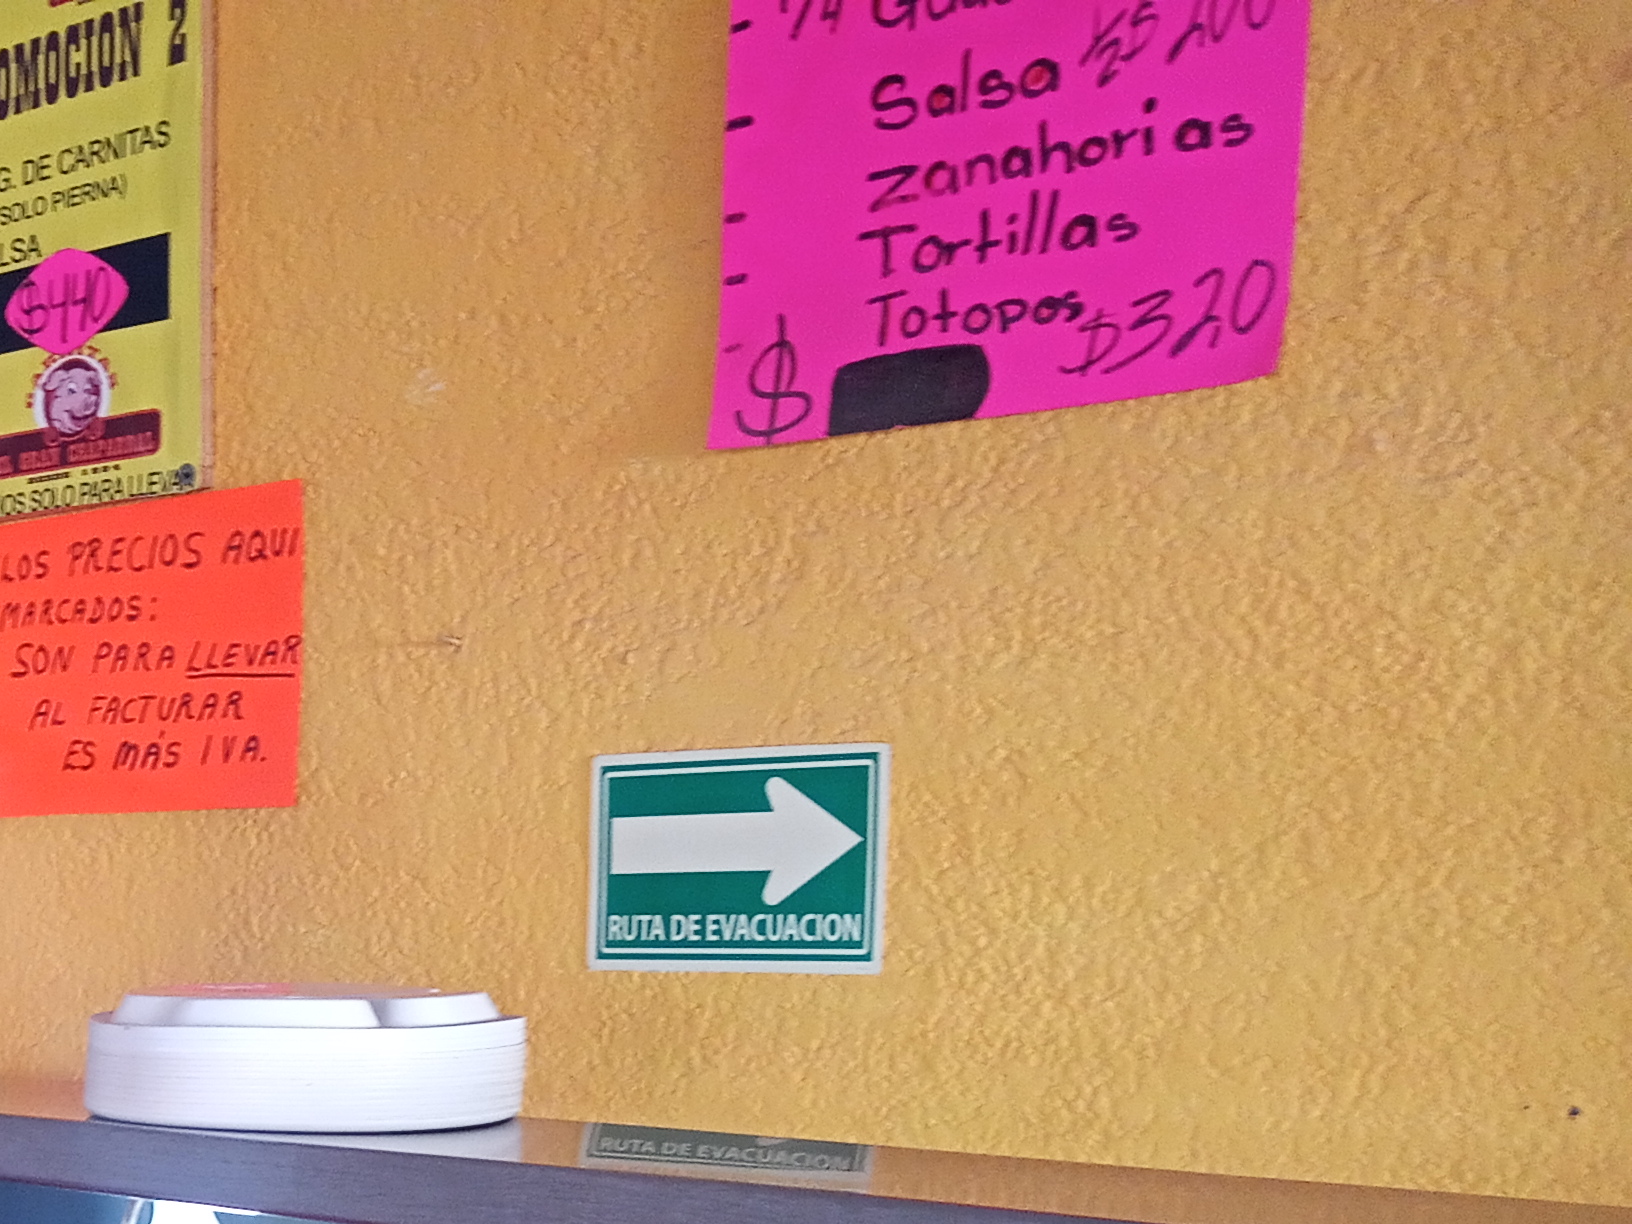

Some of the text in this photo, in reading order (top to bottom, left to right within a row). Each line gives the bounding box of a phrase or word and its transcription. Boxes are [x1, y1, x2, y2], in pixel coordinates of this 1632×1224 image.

[166, 0, 188, 67] 2
[871, 49, 1061, 130] Salsa
[22, 153, 52, 186] DE
[56, 120, 172, 176] CARNITAS
[857, 188, 1140, 280] Tortillas
[868, 286, 1085, 348] Totopos
[1058, 258, 1277, 377] $320
[734, 313, 814, 446] $
[30, 483, 78, 514] SOLO
[79, 476, 126, 506] PARA
[127, 466, 196, 498] LLEVA
[0, 526, 302, 582] LOS PRECIOS AQUI
[9, 633, 303, 679] SON PARA LLEVAR
[27, 690, 245, 732] AL FACTURAR
[61, 730, 268, 772] ES MÁS IVA.
[607, 912, 864, 943] RUTA DE EVACUACION
